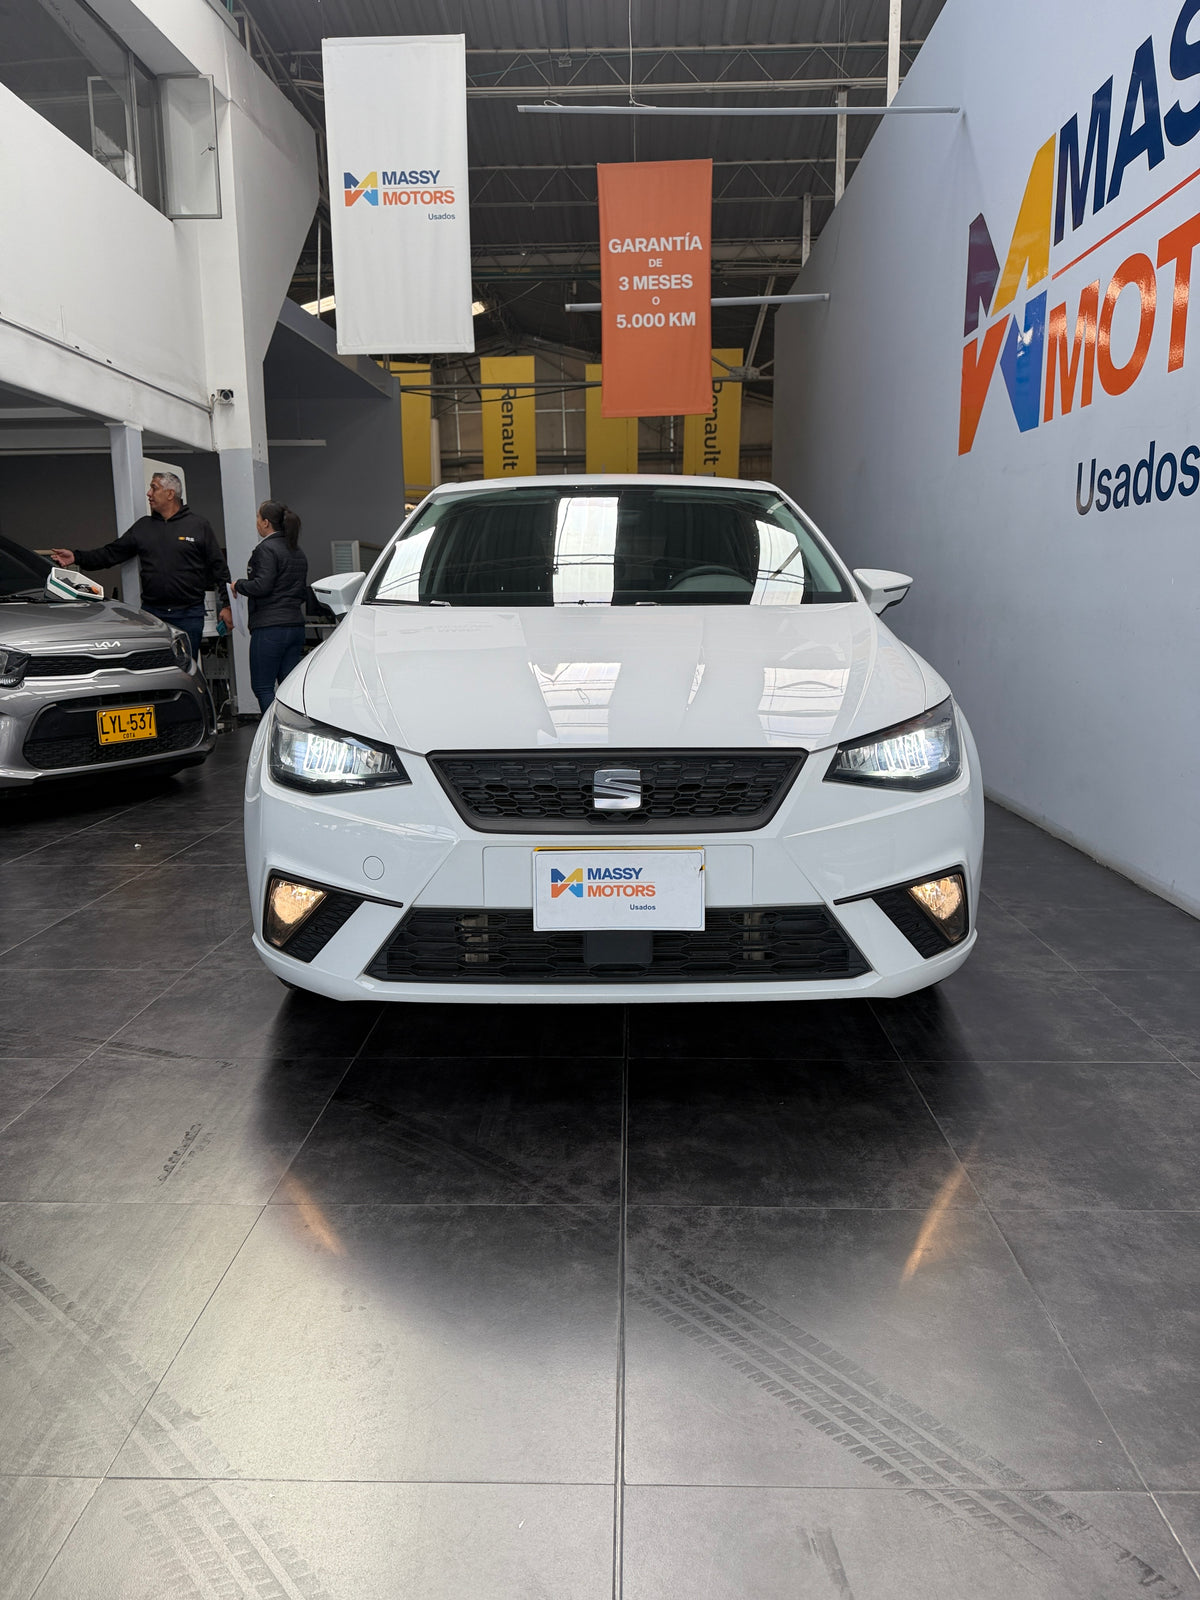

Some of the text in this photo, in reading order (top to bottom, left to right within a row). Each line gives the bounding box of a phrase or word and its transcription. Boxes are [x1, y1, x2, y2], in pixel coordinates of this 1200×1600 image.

[382, 170, 440, 185] MASSY
[382, 190, 455, 206] MOTORS
[608, 232, 702, 253] GARANTÍA
[648, 258, 663, 268] DE
[618, 274, 693, 290] 3 MESES
[616, 312, 696, 328] 5.000 KM
[500, 386, 519, 470] Renault
[1075, 440, 1200, 516] Usados
[587, 868, 643, 880] MASSY
[587, 885, 656, 898] MOTORS
